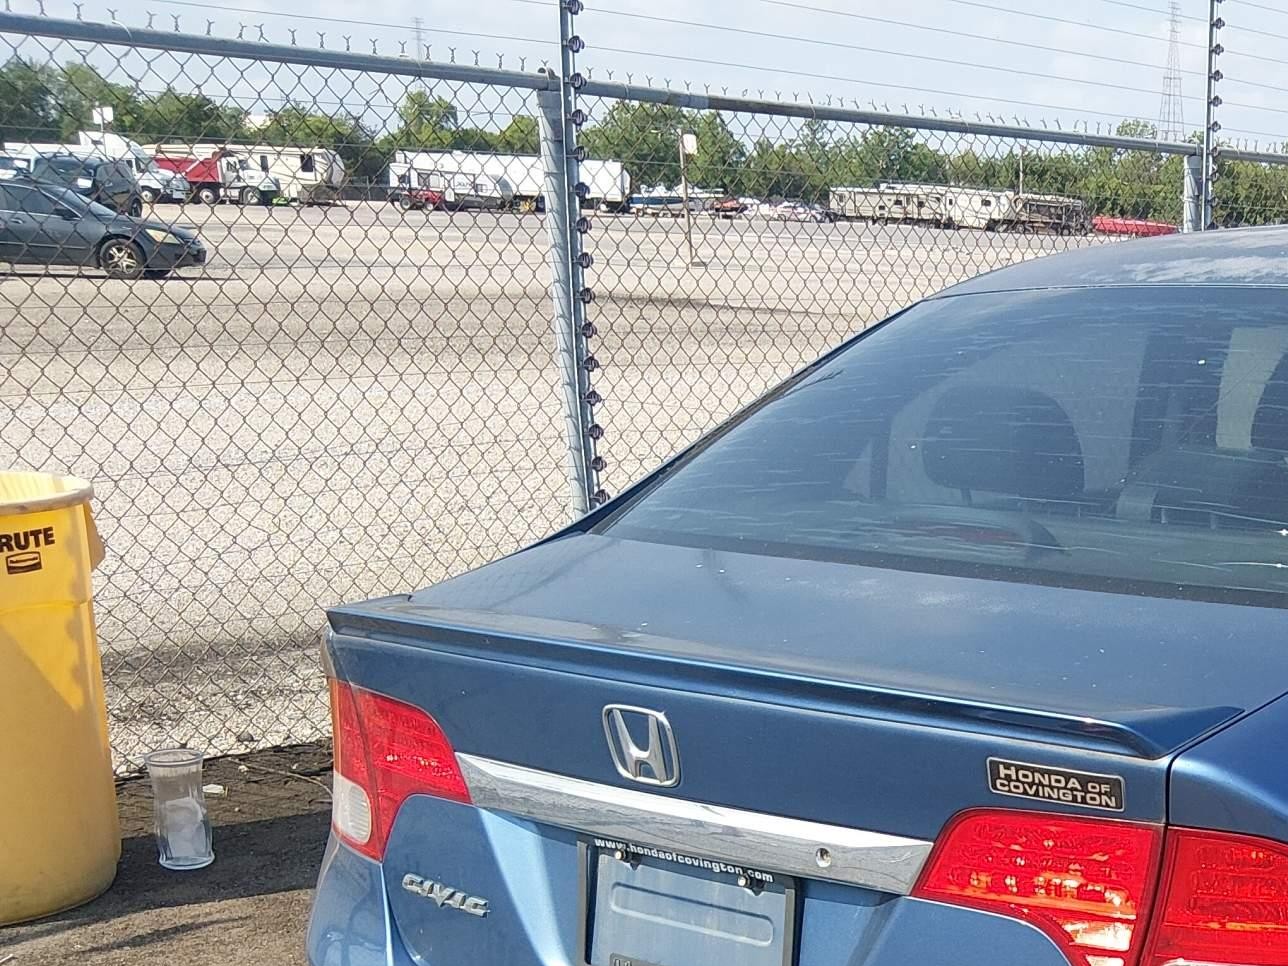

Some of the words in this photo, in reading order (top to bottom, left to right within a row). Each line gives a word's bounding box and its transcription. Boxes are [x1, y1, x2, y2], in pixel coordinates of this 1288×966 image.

[995, 779, 1117, 807] COVINGTON
[998, 764, 1082, 790] HONDA
[1087, 782, 1111, 794] OF
[402, 872, 490, 918] CIVIC
